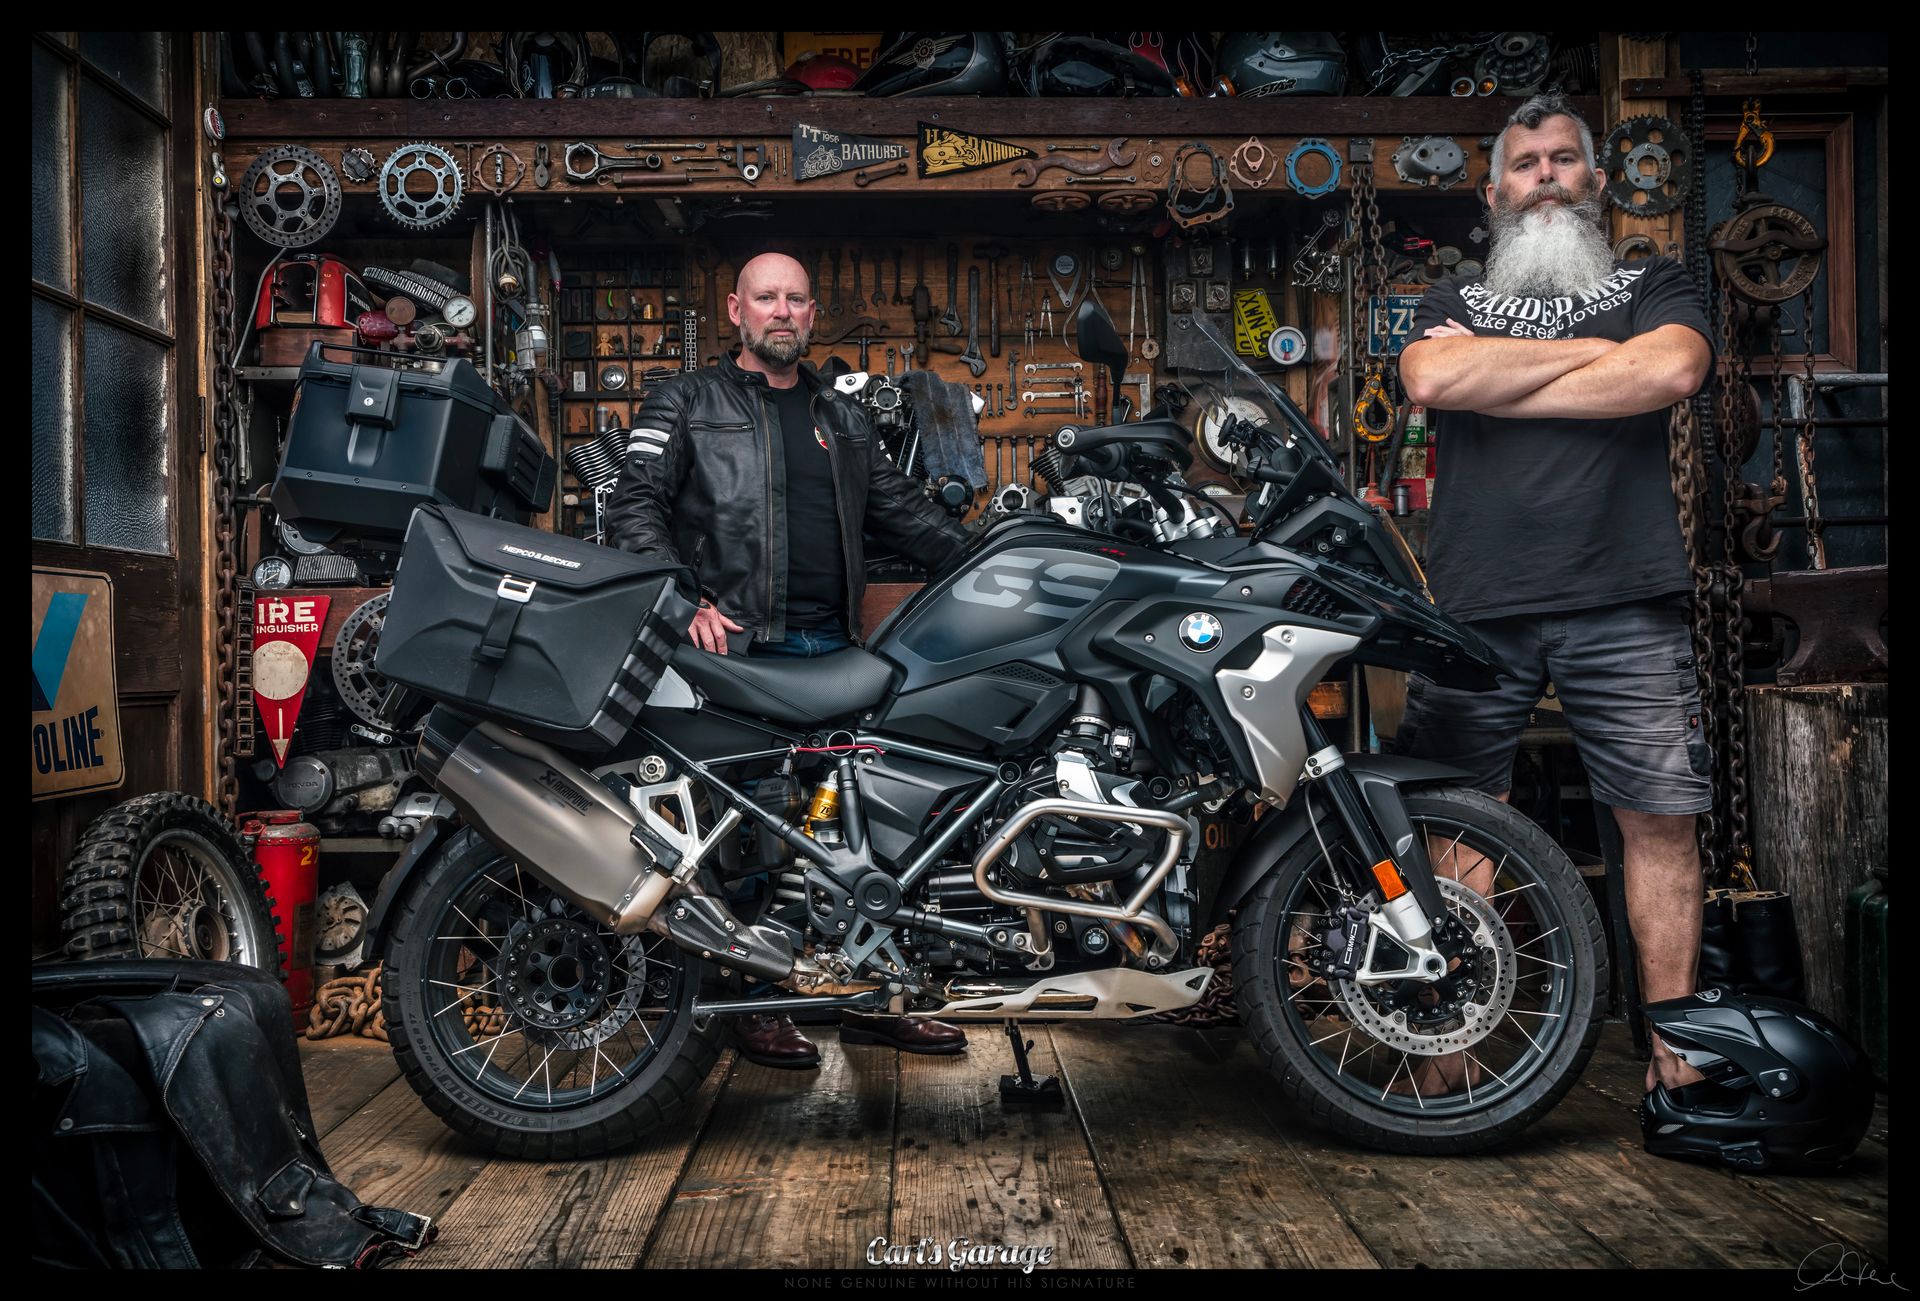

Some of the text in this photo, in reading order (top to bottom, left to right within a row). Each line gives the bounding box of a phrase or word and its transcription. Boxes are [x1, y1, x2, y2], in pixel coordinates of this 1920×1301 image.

[799, 124, 820, 143] TT
[822, 133, 840, 144] 1956
[842, 143, 903, 160] BATHURST
[1510, 318, 1564, 339] great
[1567, 290, 1632, 328] lovers
[952, 553, 1120, 622] GS
[257, 601, 316, 625] IRE
[255, 623, 319, 634] INGUISHER
[1187, 615, 1220, 632] BMW
